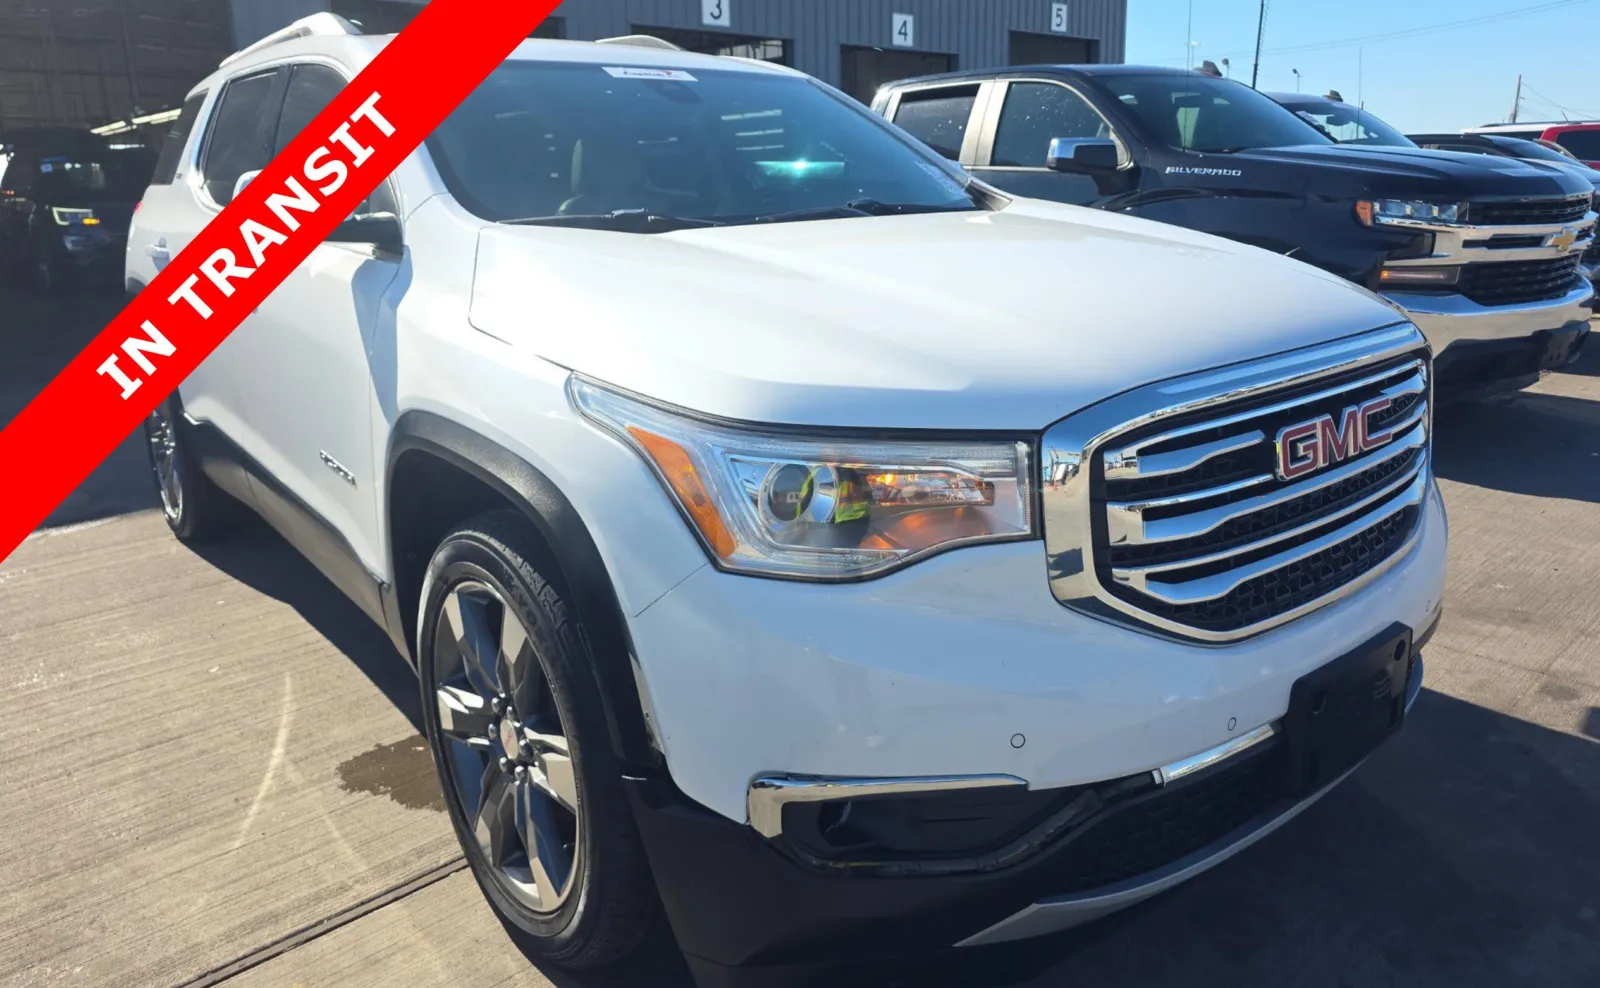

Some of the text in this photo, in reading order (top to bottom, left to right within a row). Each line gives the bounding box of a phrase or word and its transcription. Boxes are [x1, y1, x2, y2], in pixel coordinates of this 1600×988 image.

[710, 0, 722, 20] 3
[1055, 7, 1063, 27] 5
[898, 19, 908, 42] 4
[1165, 166, 1242, 176] SILVERADO
[1275, 397, 1393, 480] GMC
